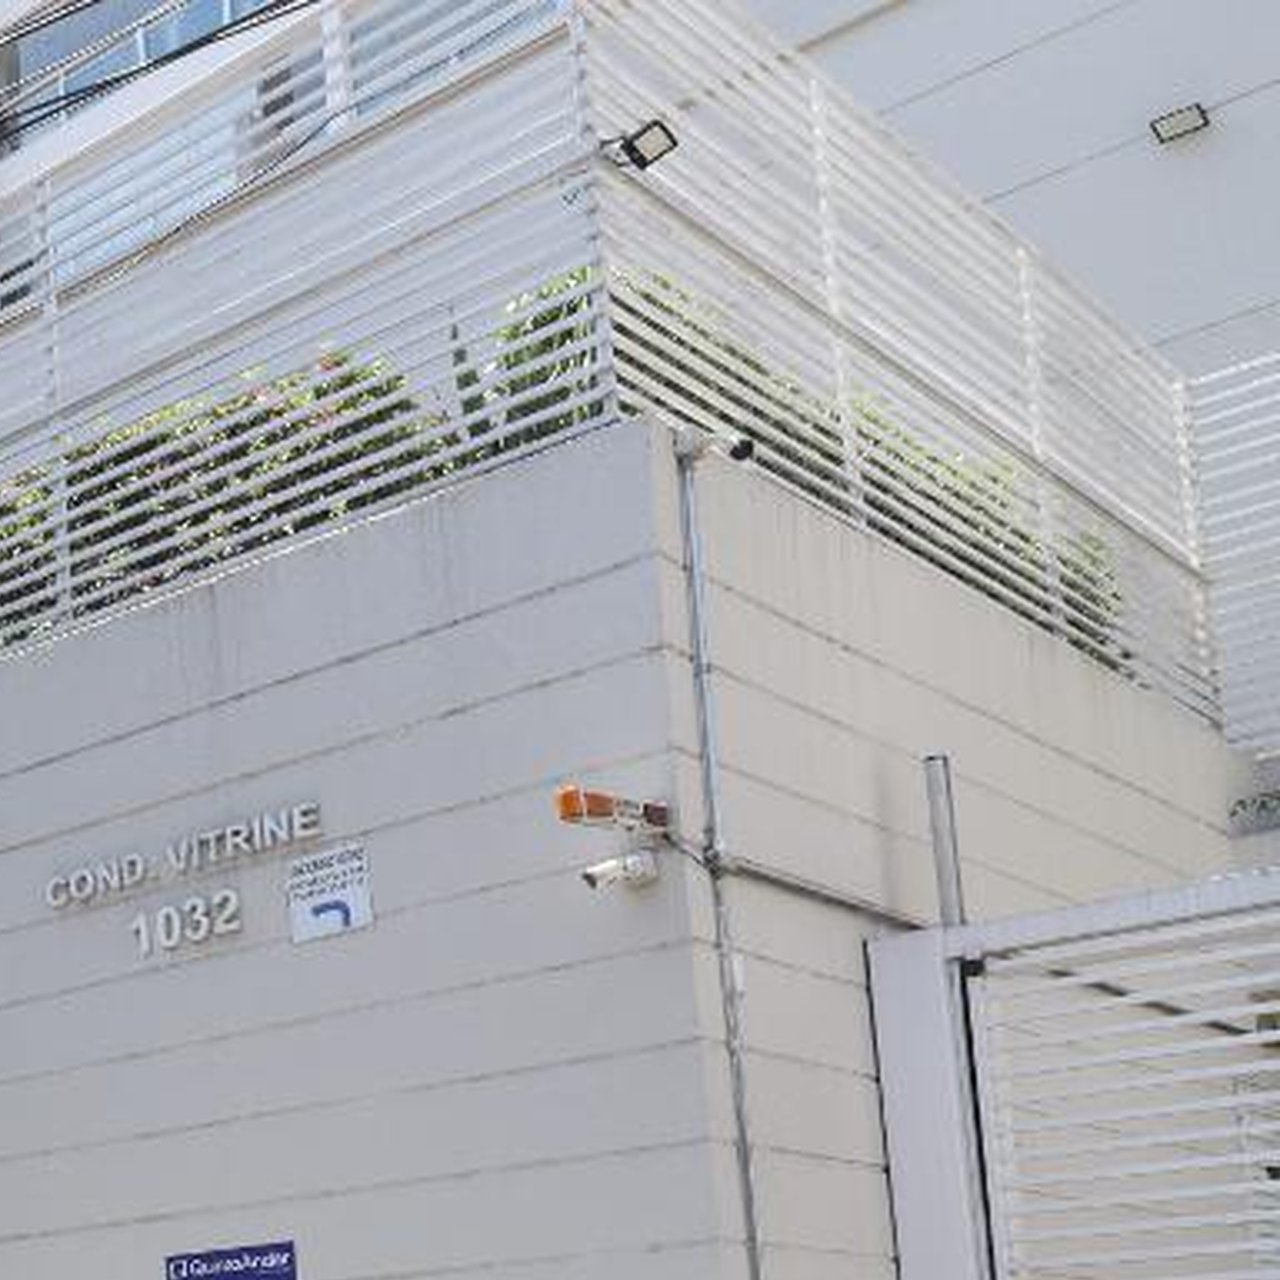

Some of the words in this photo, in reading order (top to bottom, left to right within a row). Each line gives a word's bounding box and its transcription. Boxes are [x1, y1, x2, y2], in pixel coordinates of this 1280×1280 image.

[44, 855, 157, 907] COND.
[167, 803, 322, 870] VITRINE
[132, 889, 242, 956] 1032
